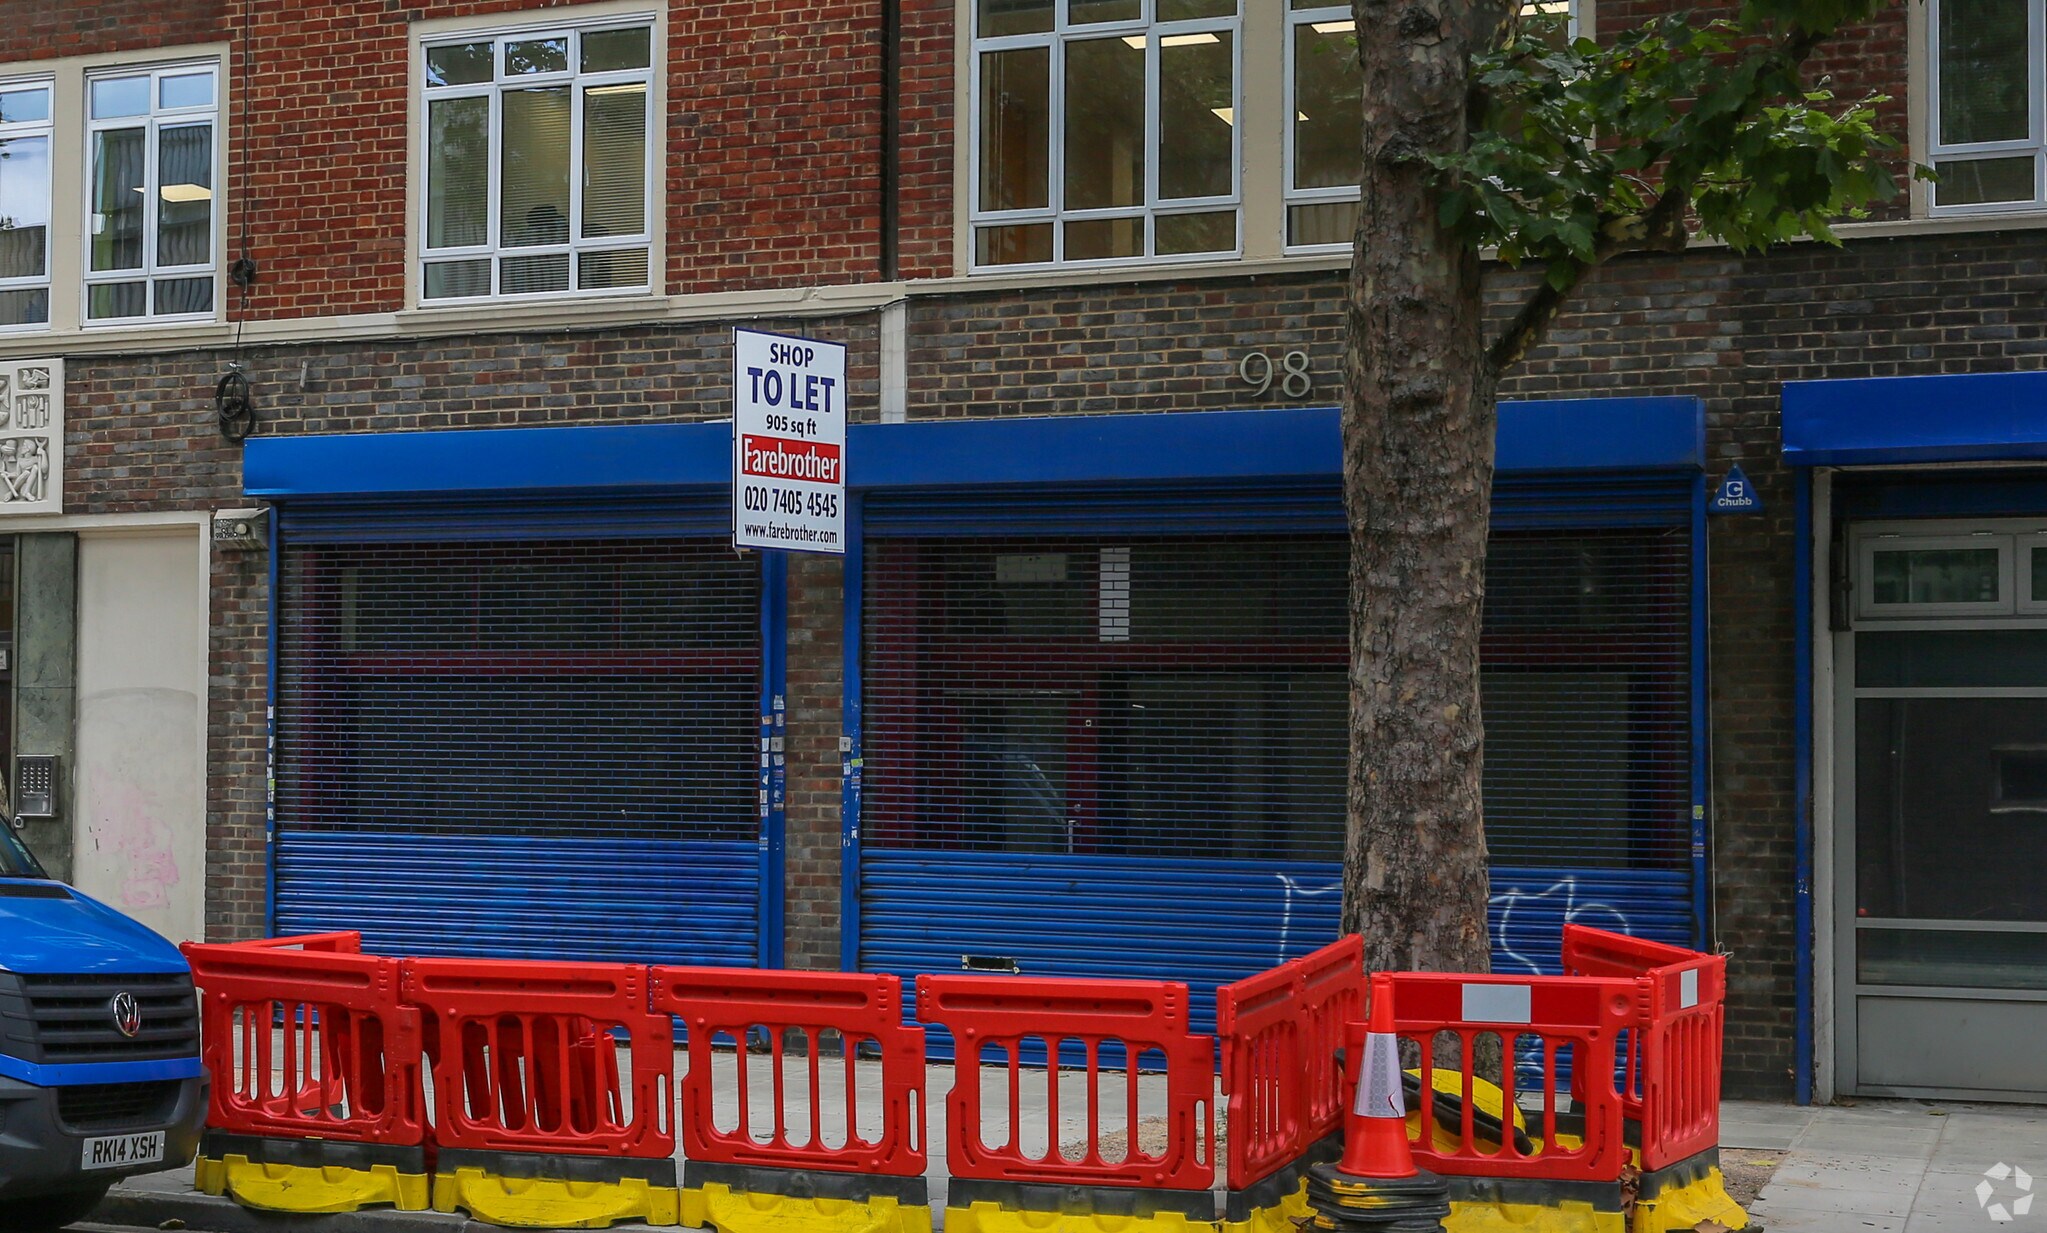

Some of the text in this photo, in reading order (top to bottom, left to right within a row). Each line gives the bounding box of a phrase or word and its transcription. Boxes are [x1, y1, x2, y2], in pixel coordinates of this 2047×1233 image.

[770, 343, 814, 368] SHOP
[1240, 350, 1311, 398] 98
[747, 367, 836, 413] TO LET
[766, 414, 817, 438] 905 sq ft
[744, 438, 838, 480] Farebrother
[744, 485, 837, 518] 020 7405 4545
[1717, 497, 1752, 506] Chubb
[744, 521, 838, 544] www.farebrother.com
[92, 1135, 158, 1164] RK14 XSH
